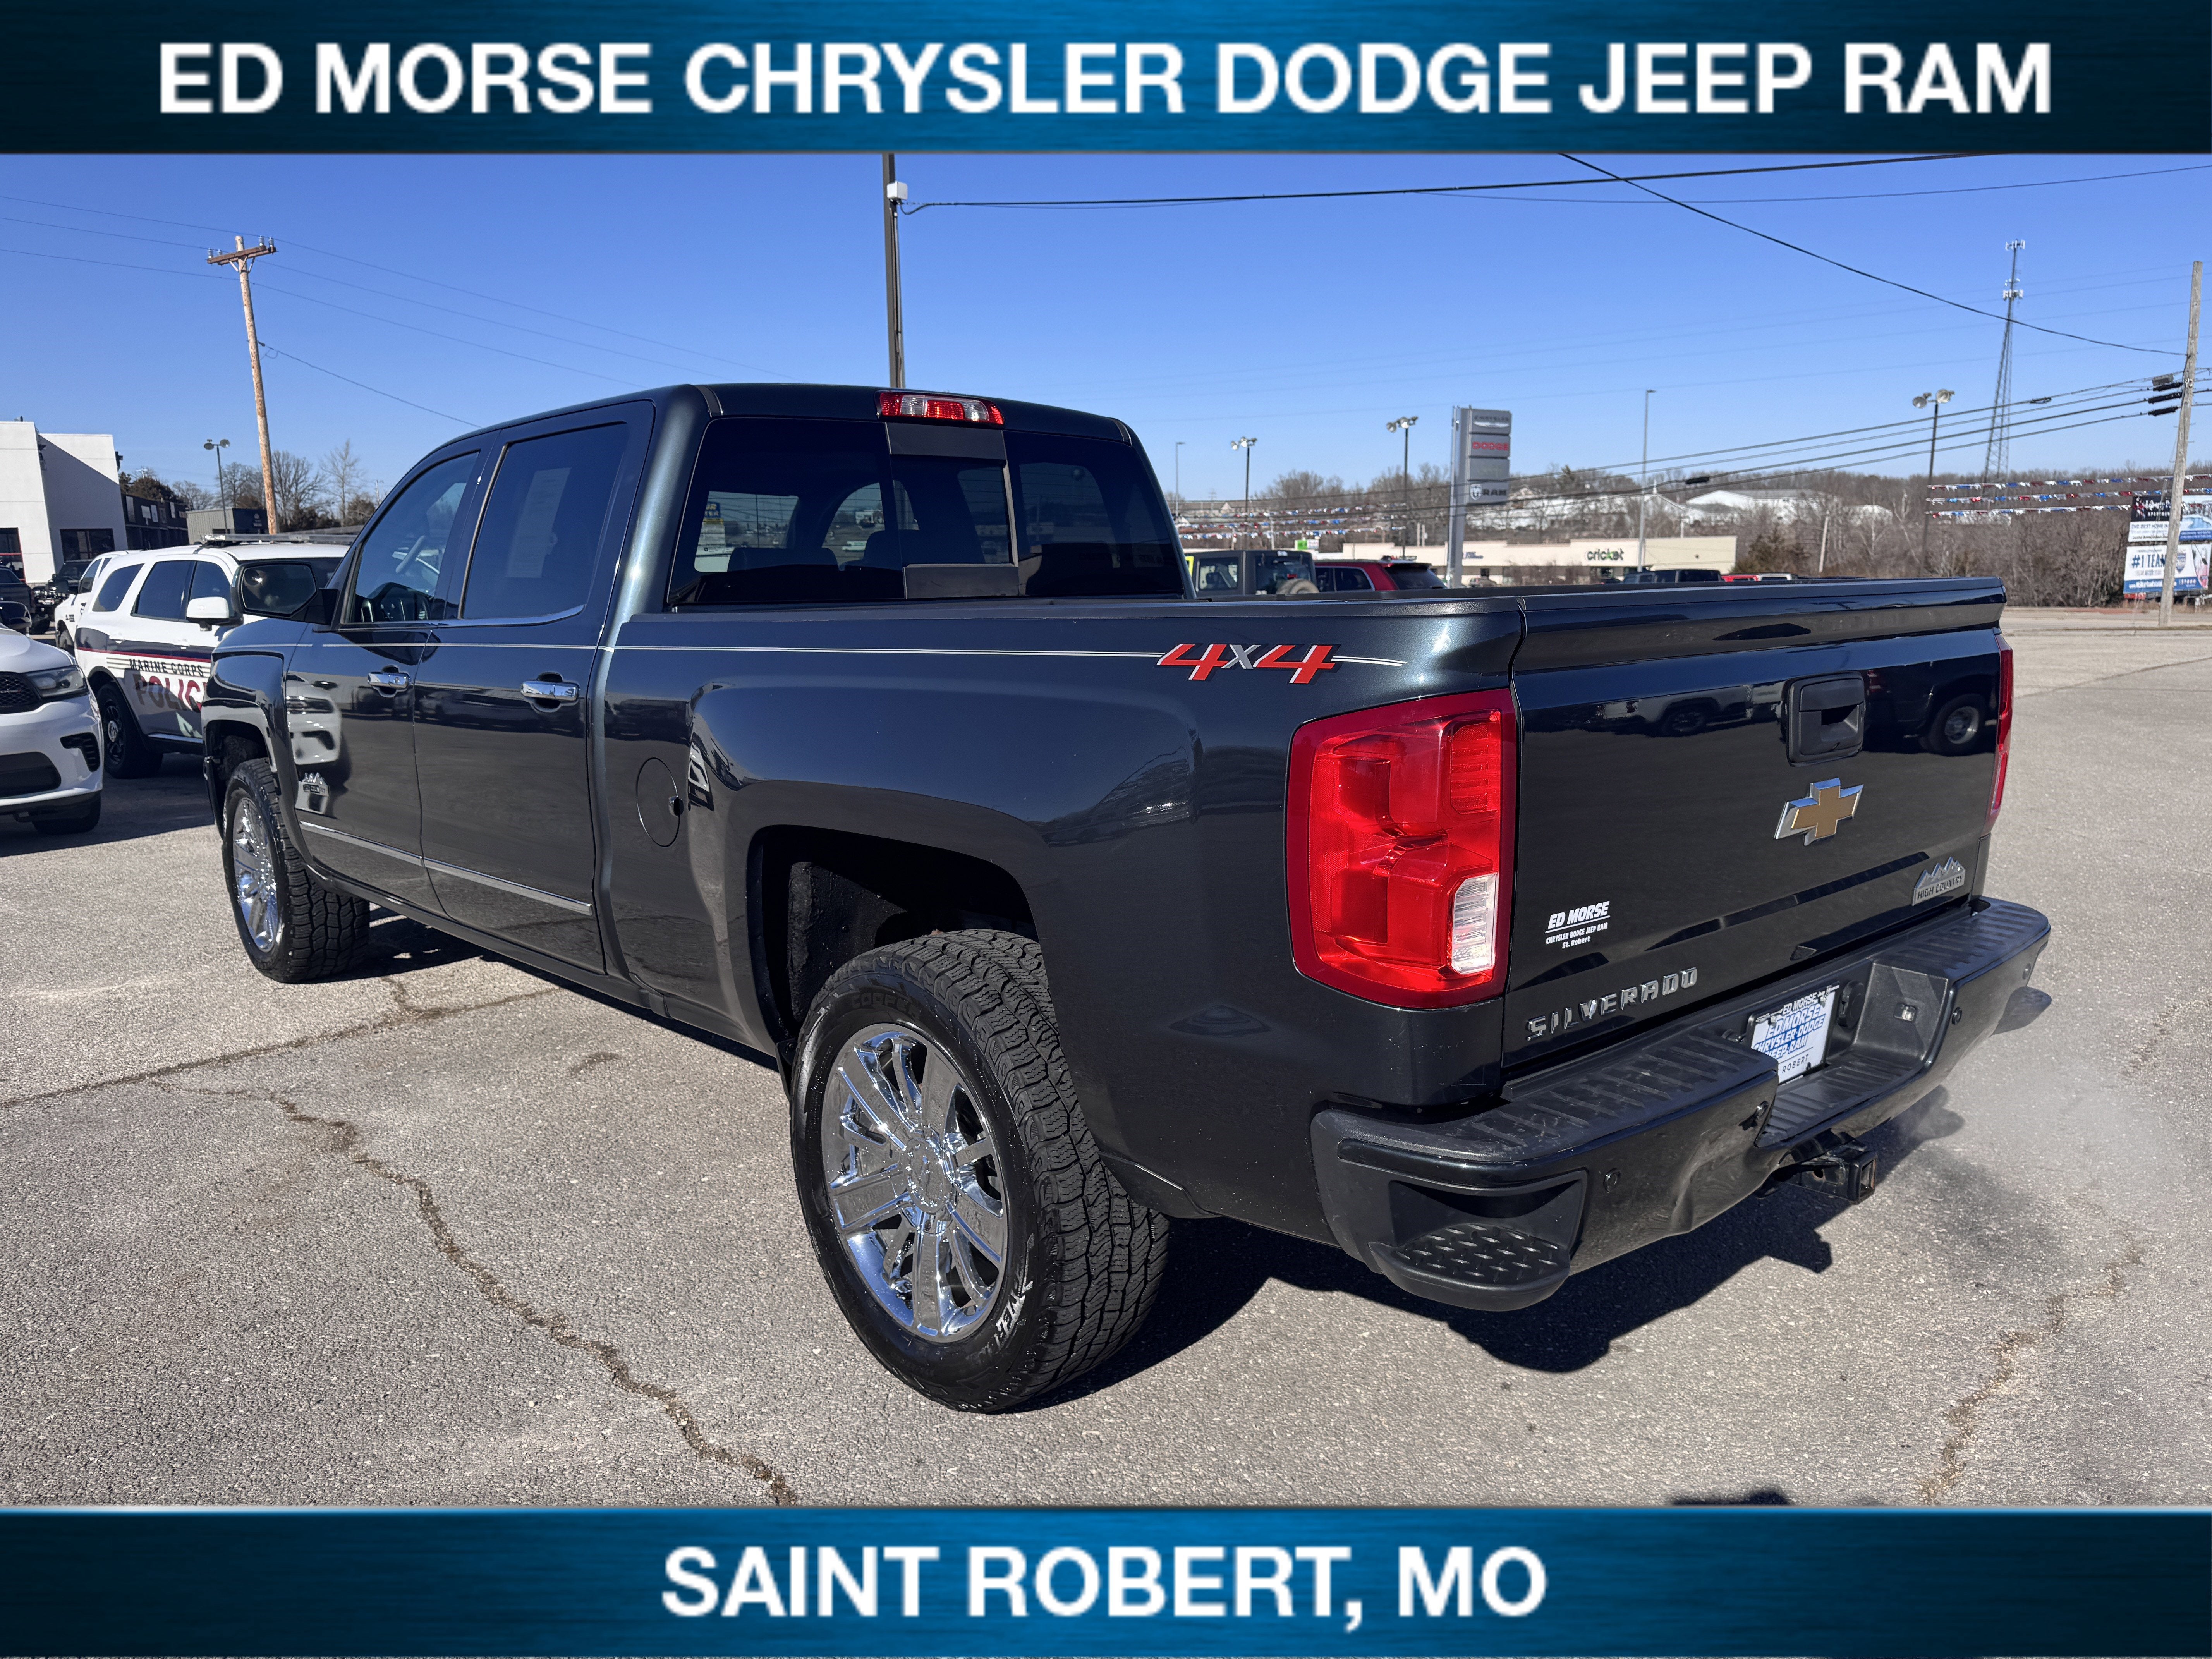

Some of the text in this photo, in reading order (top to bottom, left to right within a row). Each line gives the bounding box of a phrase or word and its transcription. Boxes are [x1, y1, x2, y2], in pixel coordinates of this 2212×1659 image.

[1473, 442, 1509, 451] DODGE
[1587, 548, 1624, 560] cricket
[129, 659, 204, 677] MARINE CORPS
[133, 674, 208, 713] POLIC
[1917, 875, 1962, 900] HIGH COUNTRY
[1548, 901, 1610, 929] ED MORSE
[1546, 922, 1608, 945] CHRYSLER DODGE JEEP RAM
[1571, 936, 1591, 946] Robert
[1527, 967, 1698, 1041] SILVERADO
[1782, 992, 1818, 1016] ED MORSE
[1766, 1003, 1821, 1039] ED MORSE
[1796, 1014, 1826, 1038] DODGE
[1788, 1034, 1809, 1054] RAM
[1782, 1054, 1809, 1074] ROBERT
